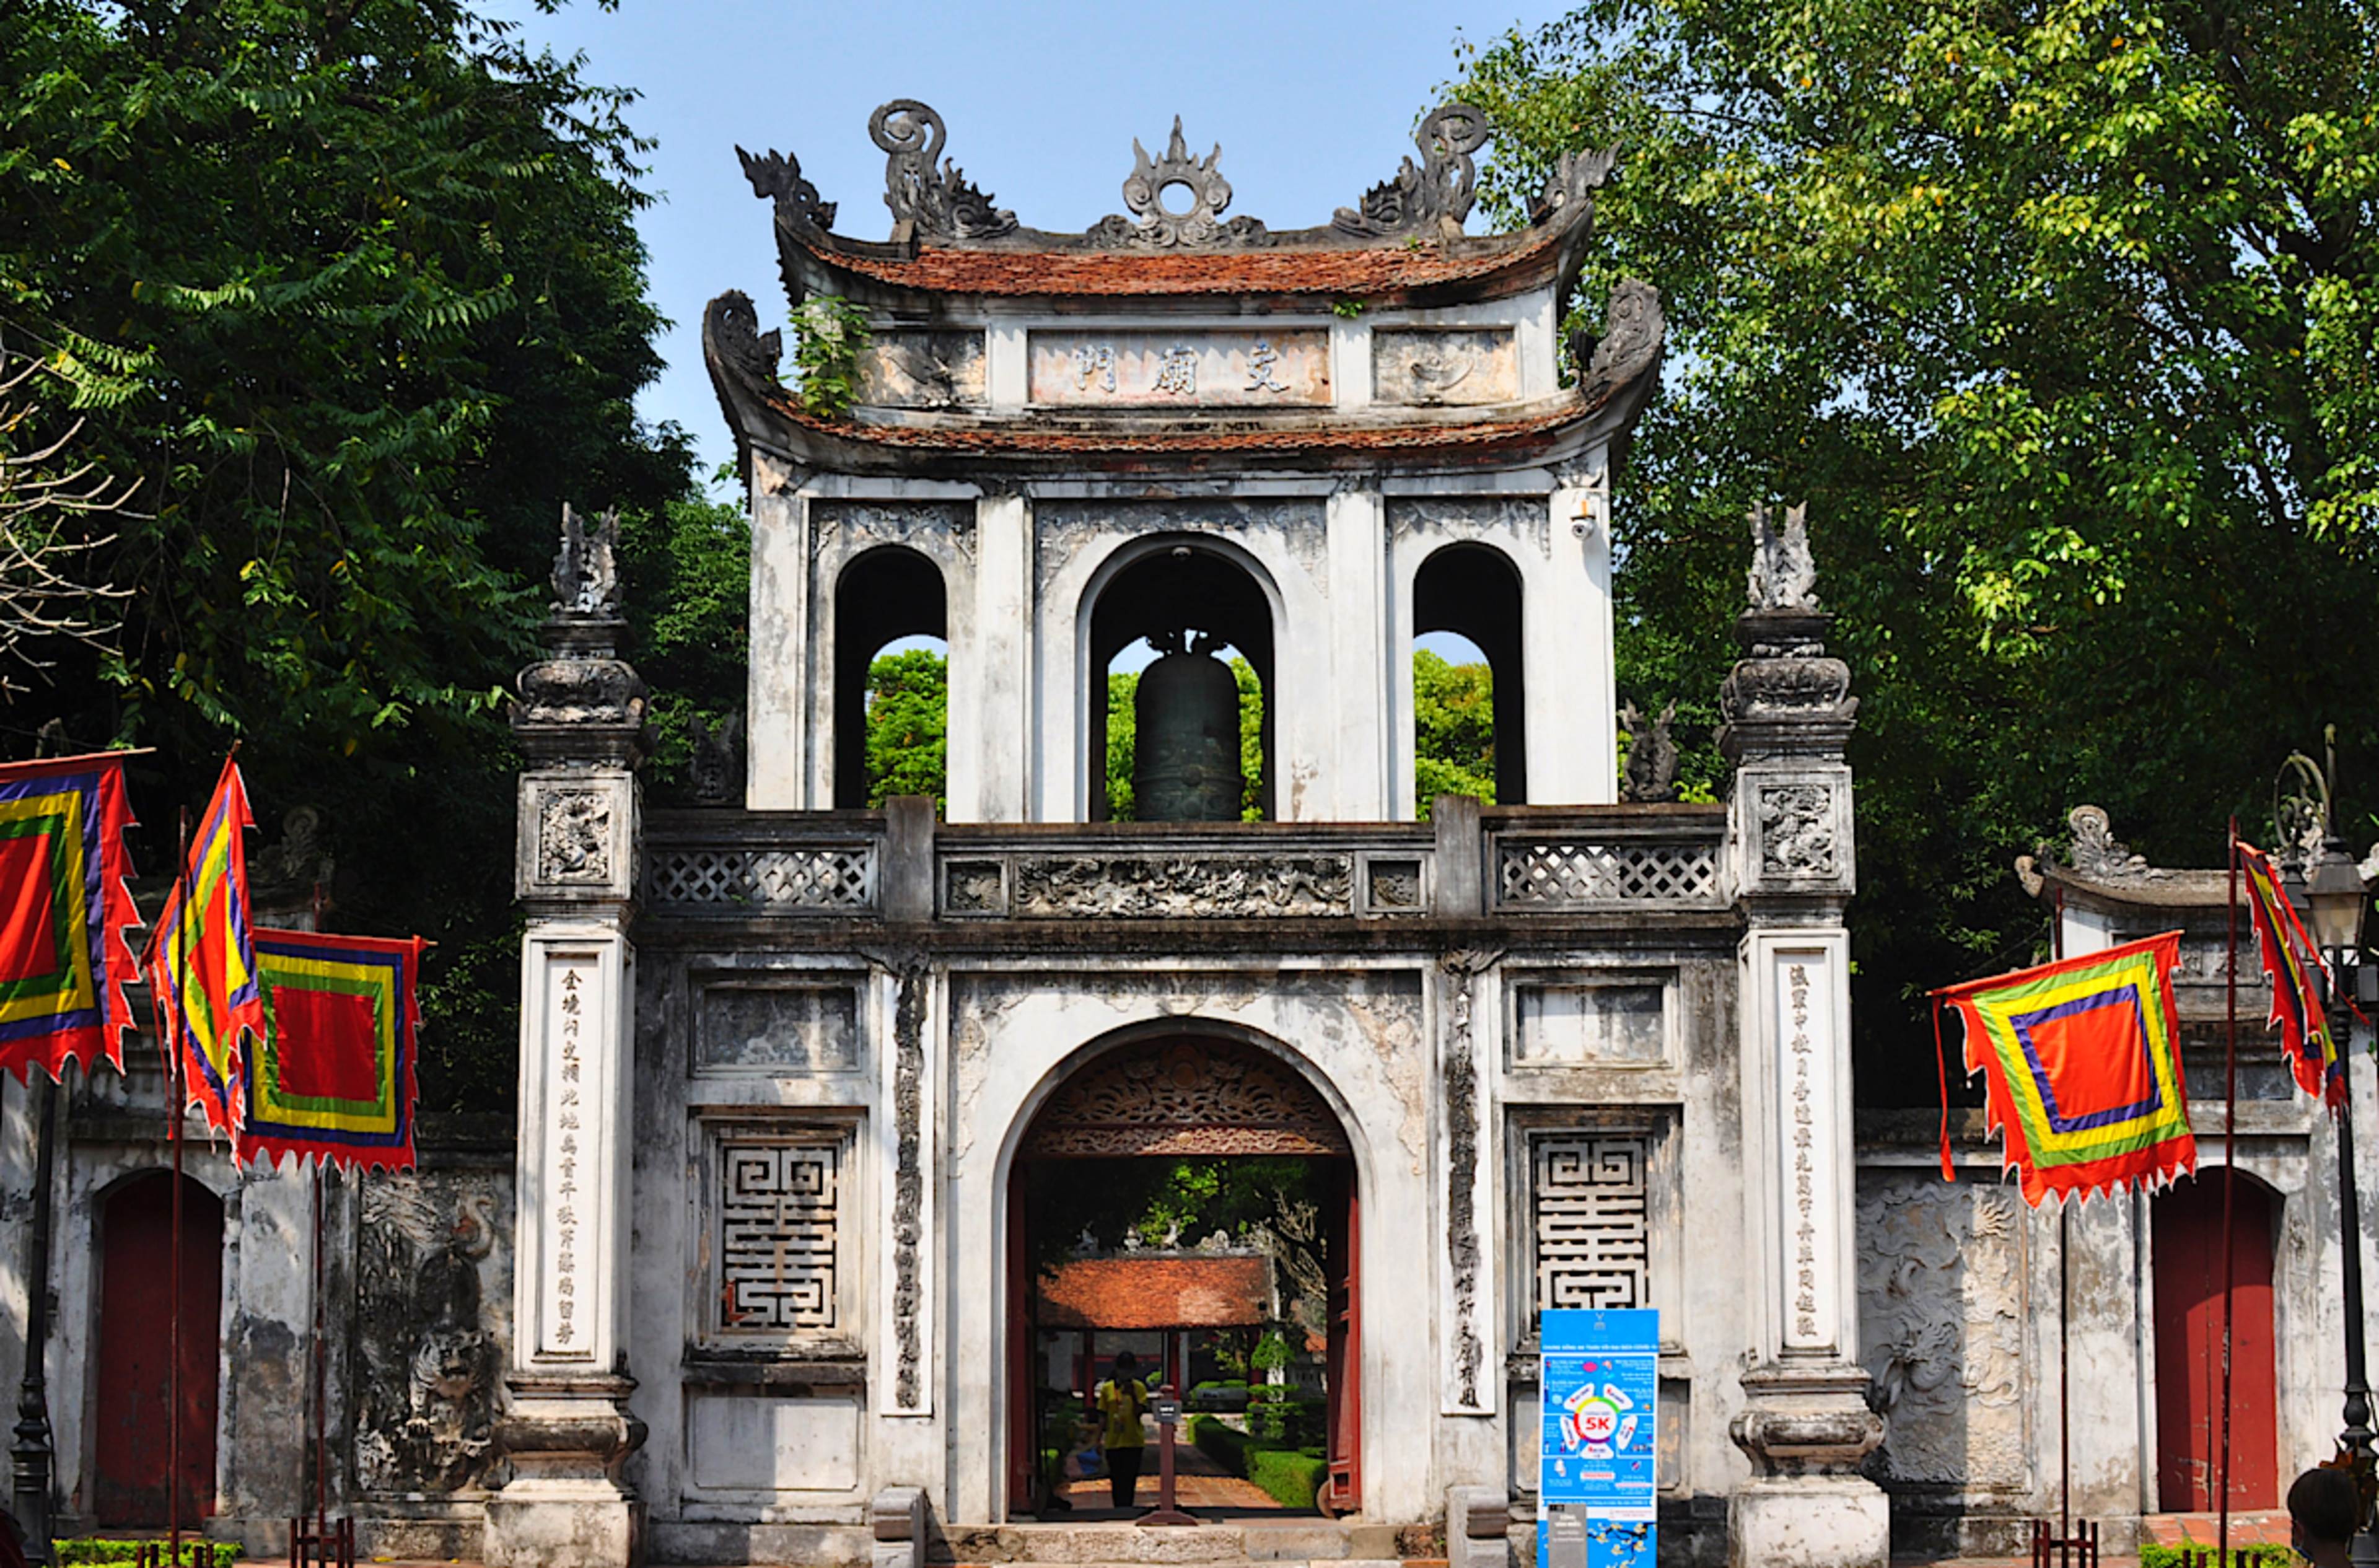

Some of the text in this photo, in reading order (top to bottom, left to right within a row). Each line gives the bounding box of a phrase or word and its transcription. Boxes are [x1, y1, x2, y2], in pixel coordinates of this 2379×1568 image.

[1074, 341, 1290, 395] 文廟門
[1585, 1417, 1610, 1430] 5K
